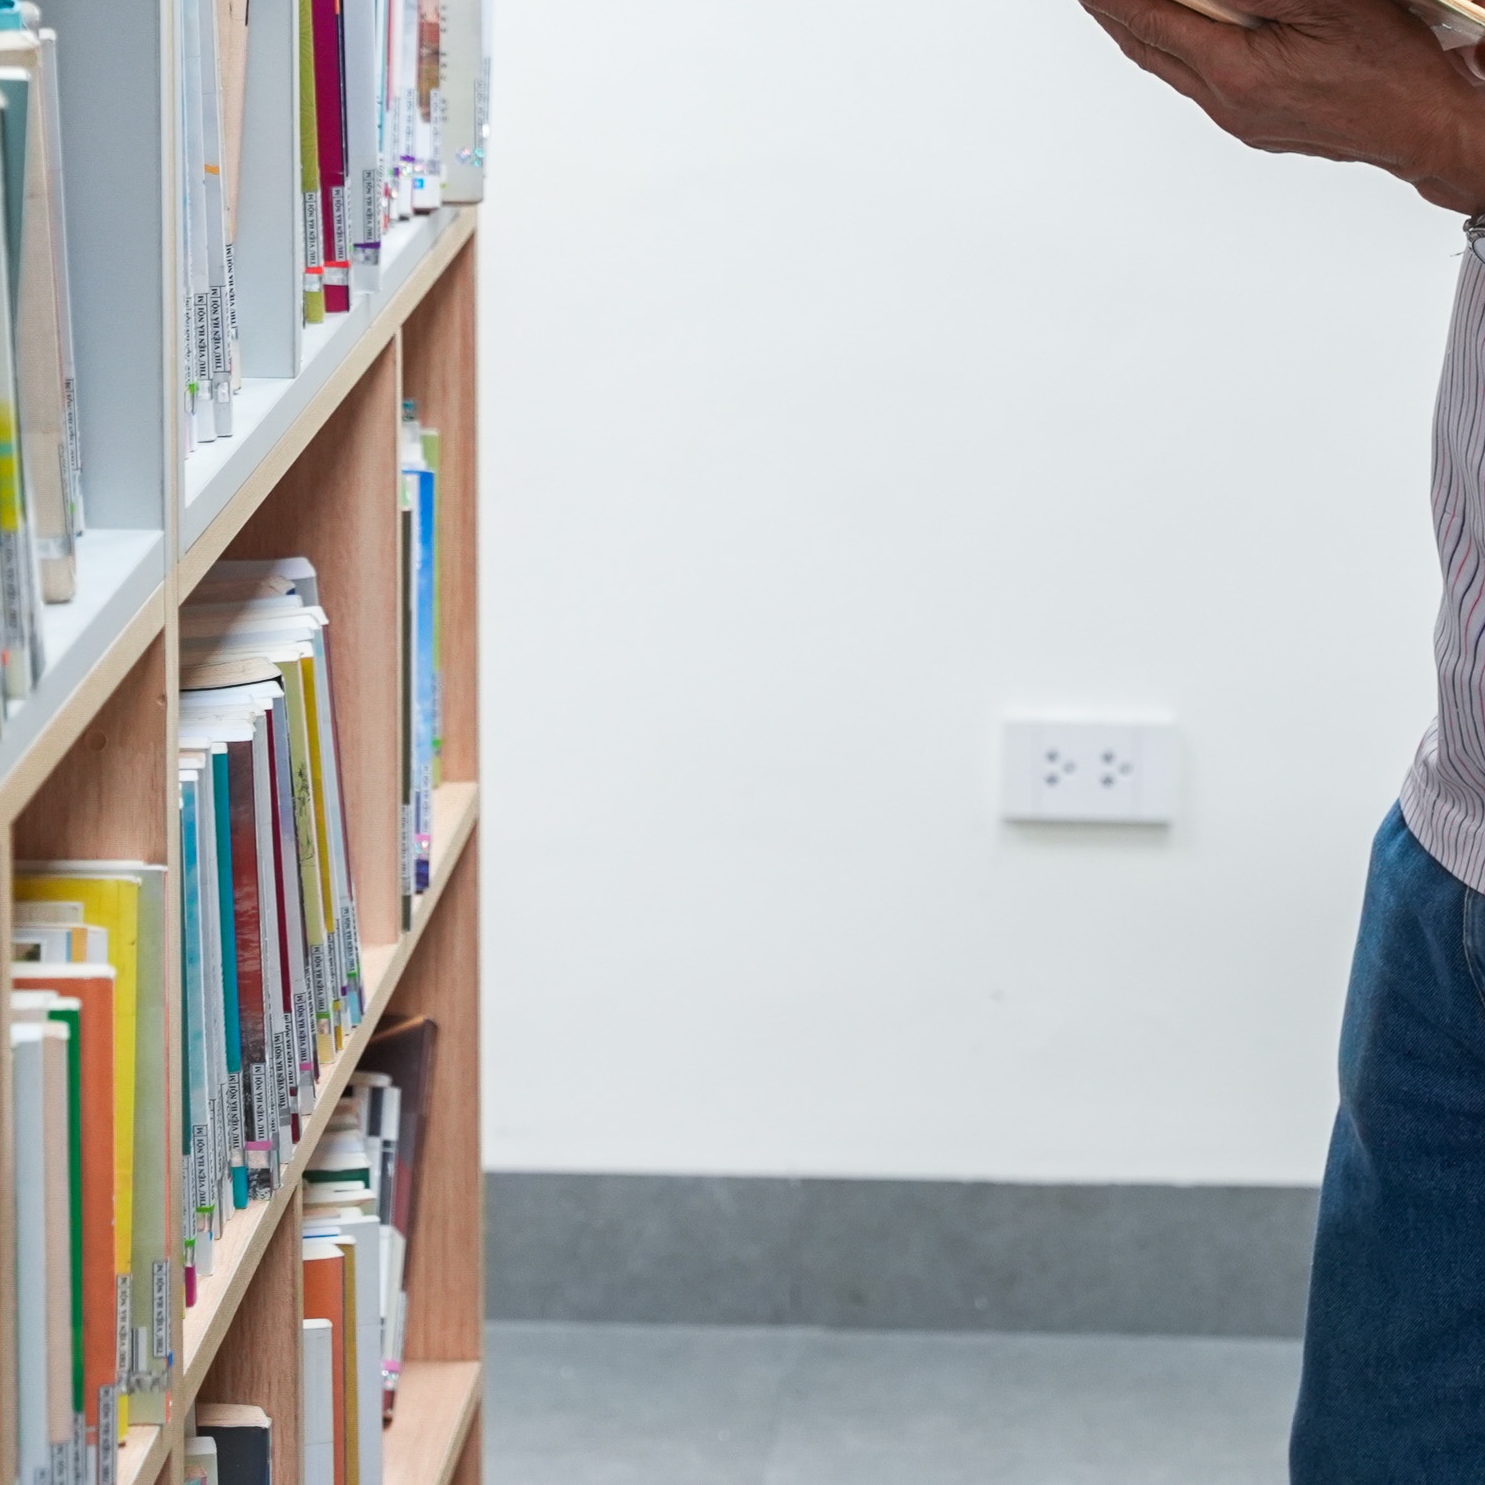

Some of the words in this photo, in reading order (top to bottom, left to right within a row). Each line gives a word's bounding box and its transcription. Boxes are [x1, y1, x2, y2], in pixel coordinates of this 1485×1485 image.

[307, 204, 315, 216] NỘI
[307, 218, 315, 229] HÀ
[308, 231, 316, 247] VIỆN
[197, 295, 204, 303] M
[196, 307, 205, 322] NỘI
[211, 300, 220, 315] NỘI
[211, 317, 220, 328] HÀ
[196, 325, 205, 336] HÀ
[197, 338, 206, 357] VIỆN
[212, 330, 222, 350] VIỆN
[214, 352, 222, 369] THƯ
[198, 360, 206, 377] THƯ
[314, 955, 323, 967] NỘI
[314, 968, 322, 979] HÀ
[316, 980, 324, 995] VIỆN
[297, 1018, 305, 1029] HÀ
[299, 1030, 307, 1046] VIỆN
[274, 1044, 283, 1059] NỘI
[300, 1047, 308, 1062] THƯ
[255, 1077, 264, 1090] NỘI
[277, 1072, 285, 1089] VIỆN
[229, 1085, 237, 1099] NỘI
[254, 1092, 263, 1103] HÀ
[278, 1091, 286, 1108] THƯ
[228, 1100, 237, 1112] HÀ
[256, 1104, 265, 1122] VIỆN
[230, 1114, 240, 1131] VIỆN
[196, 1127, 203, 1135] M
[257, 1124, 265, 1140] THƯ
[196, 1138, 205, 1153] NỘI
[231, 1133, 240, 1149] THƯ
[195, 1155, 205, 1166] HÀ
[197, 1168, 207, 1188] VIỆN
[198, 1189, 206, 1206] THƯ
